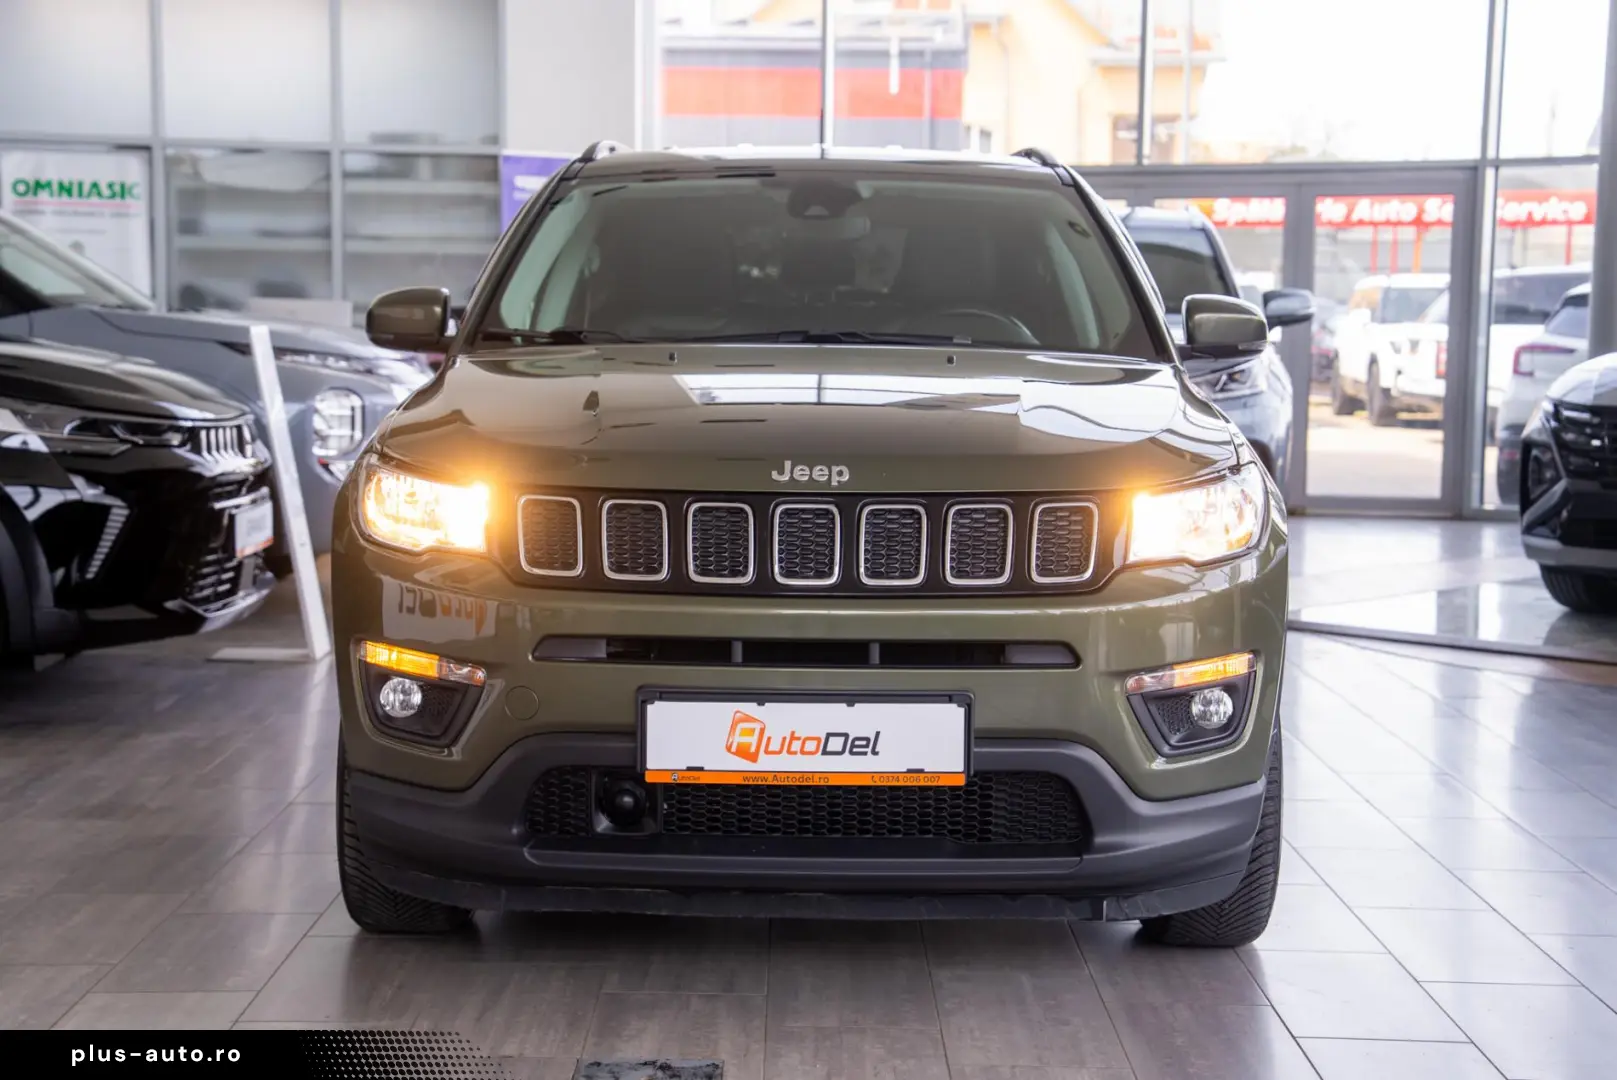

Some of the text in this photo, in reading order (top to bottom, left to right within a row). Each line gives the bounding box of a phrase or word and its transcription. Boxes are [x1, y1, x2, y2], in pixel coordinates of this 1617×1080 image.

[1352, 198, 1417, 222] Auto
[771, 460, 850, 486] Jeep
[726, 712, 881, 762] AutoDel
[742, 774, 830, 785] www.Autodel.ro
[923, 775, 941, 784] 007
